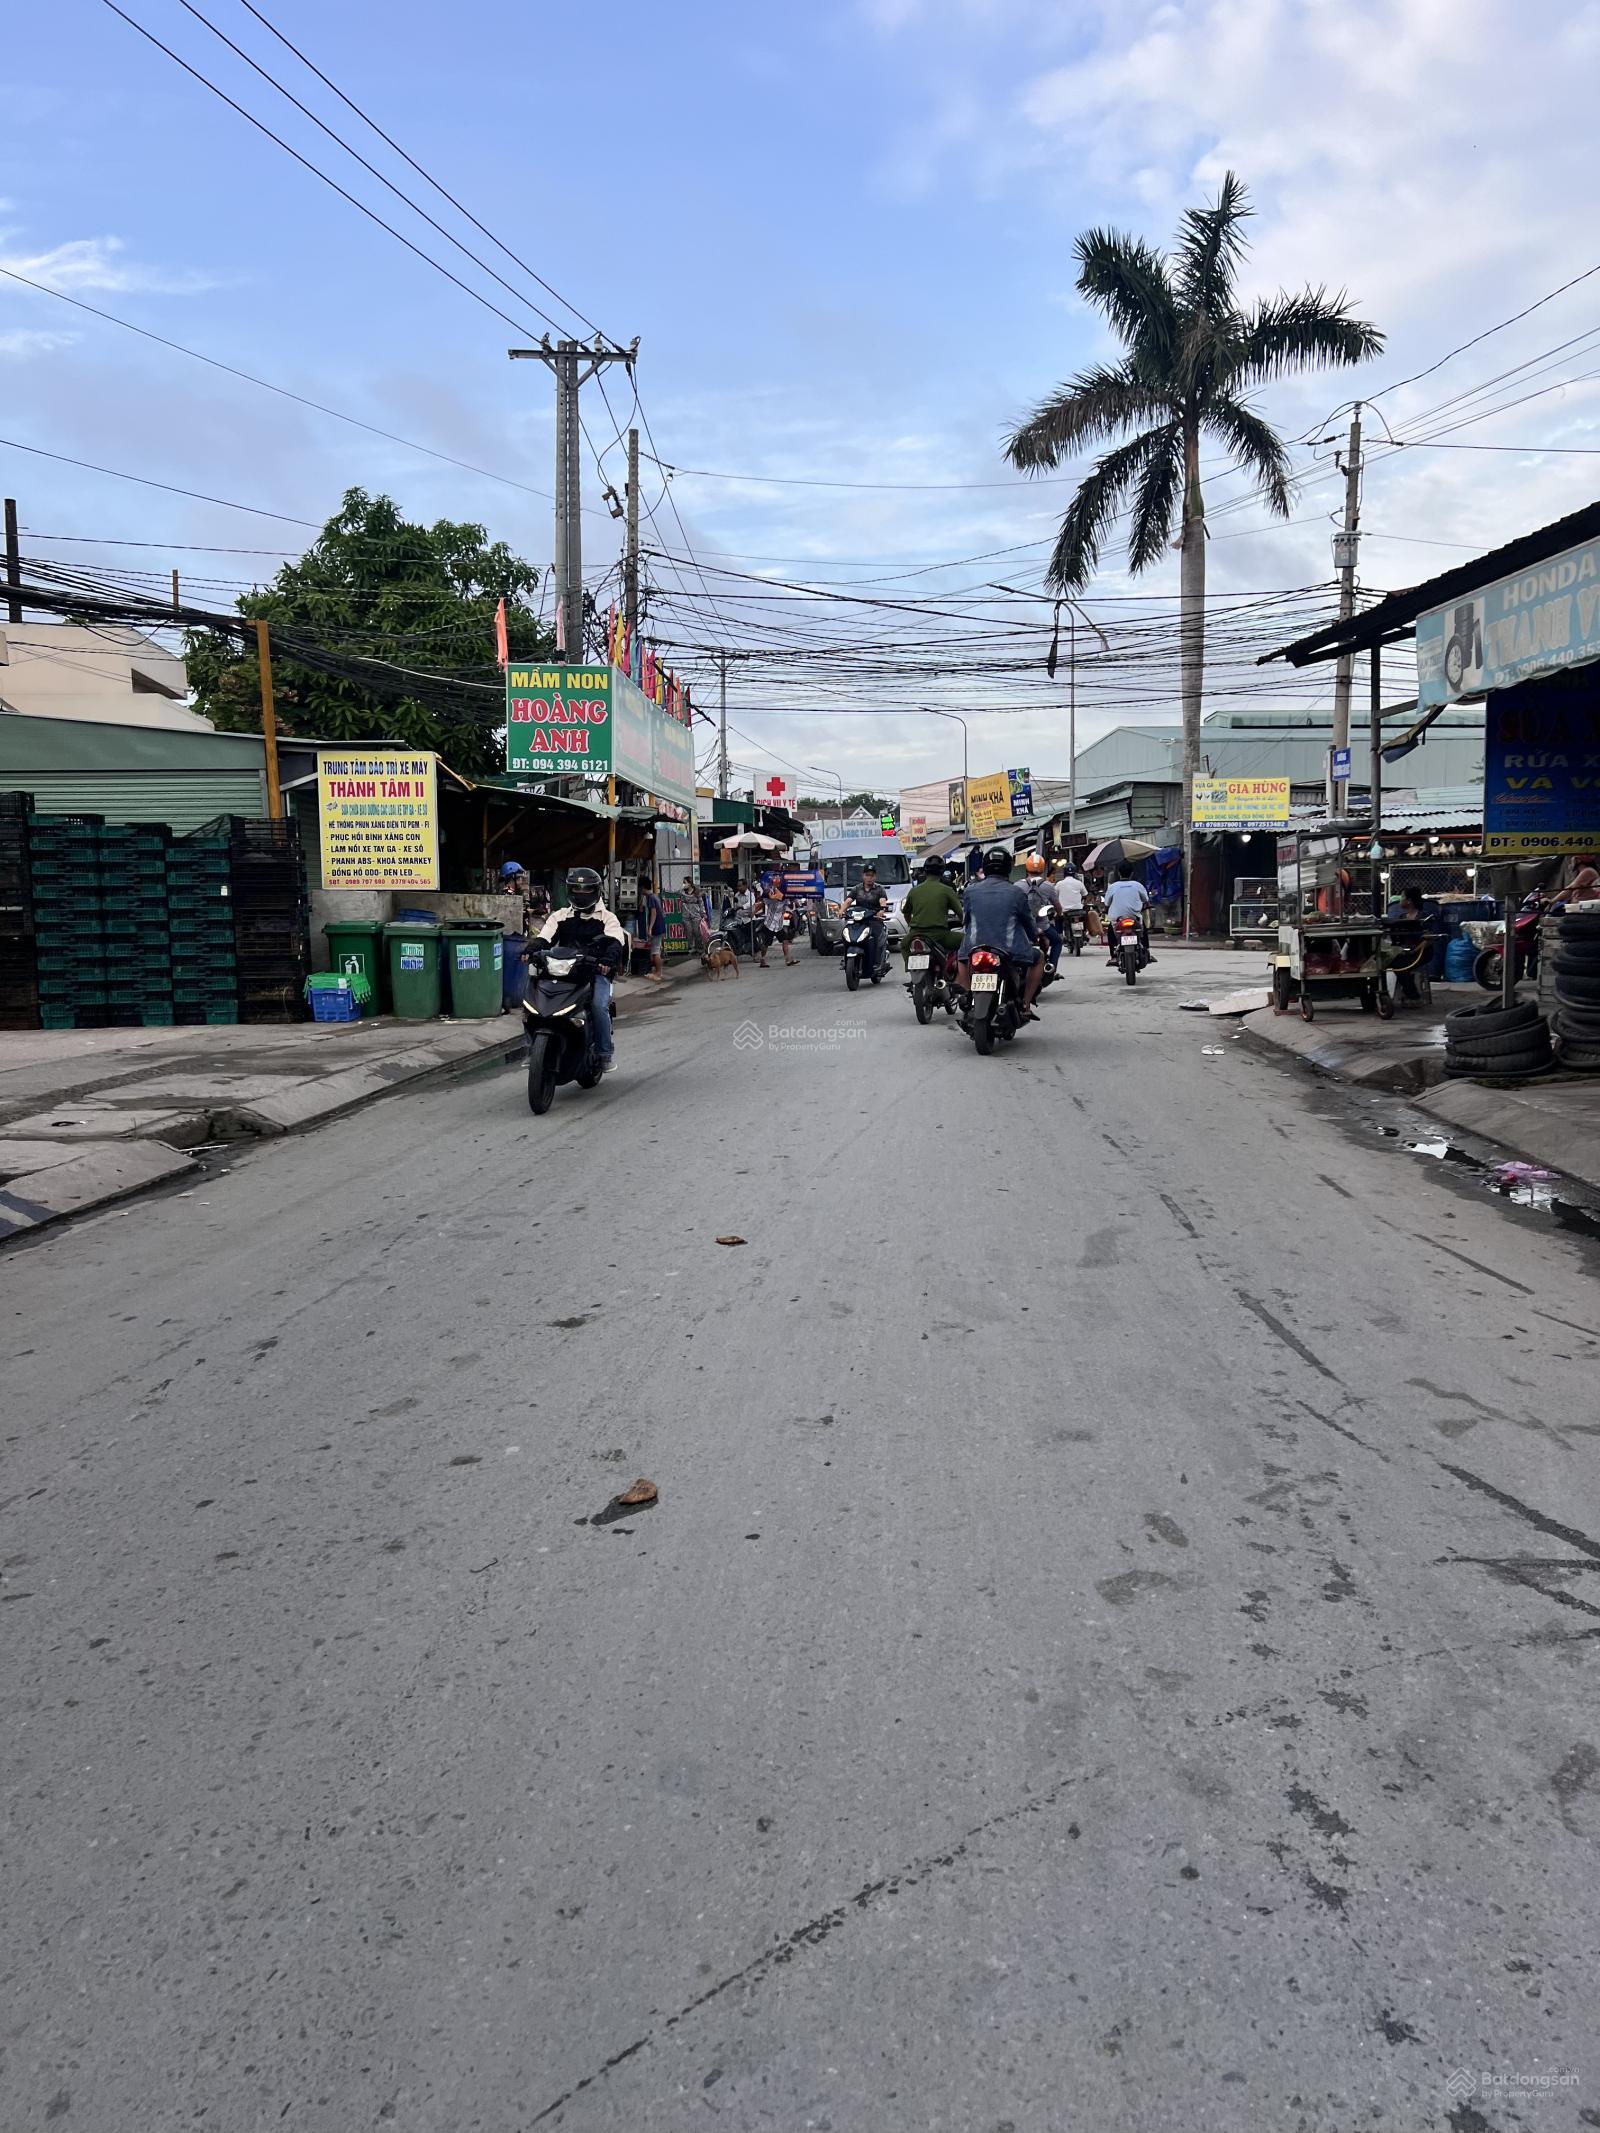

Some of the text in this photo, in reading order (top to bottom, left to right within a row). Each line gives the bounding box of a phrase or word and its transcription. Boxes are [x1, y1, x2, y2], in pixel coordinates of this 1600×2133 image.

[1503, 552, 1597, 610] HONDA
[511, 667, 608, 689] MẦM NON
[511, 692, 608, 724] HOÀNG
[530, 728, 589, 753] ANH
[323, 761, 348, 775] TRUNG
[350, 758, 366, 775] TÂM
[369, 756, 383, 775] BẢO
[400, 761, 409, 775] XE
[412, 758, 428, 775] MÁY
[512, 758, 608, 771] ĐT: 094 394 6121
[1503, 748, 1569, 768] RỬA
[329, 778, 424, 797] THÀNH TÂM II
[1228, 780, 1287, 794] GIA HÙNG
[1505, 773, 1553, 790] VÁ
[331, 833, 349, 842] PHỤC
[1491, 836, 1600, 848] ĐT: 0906.440.
